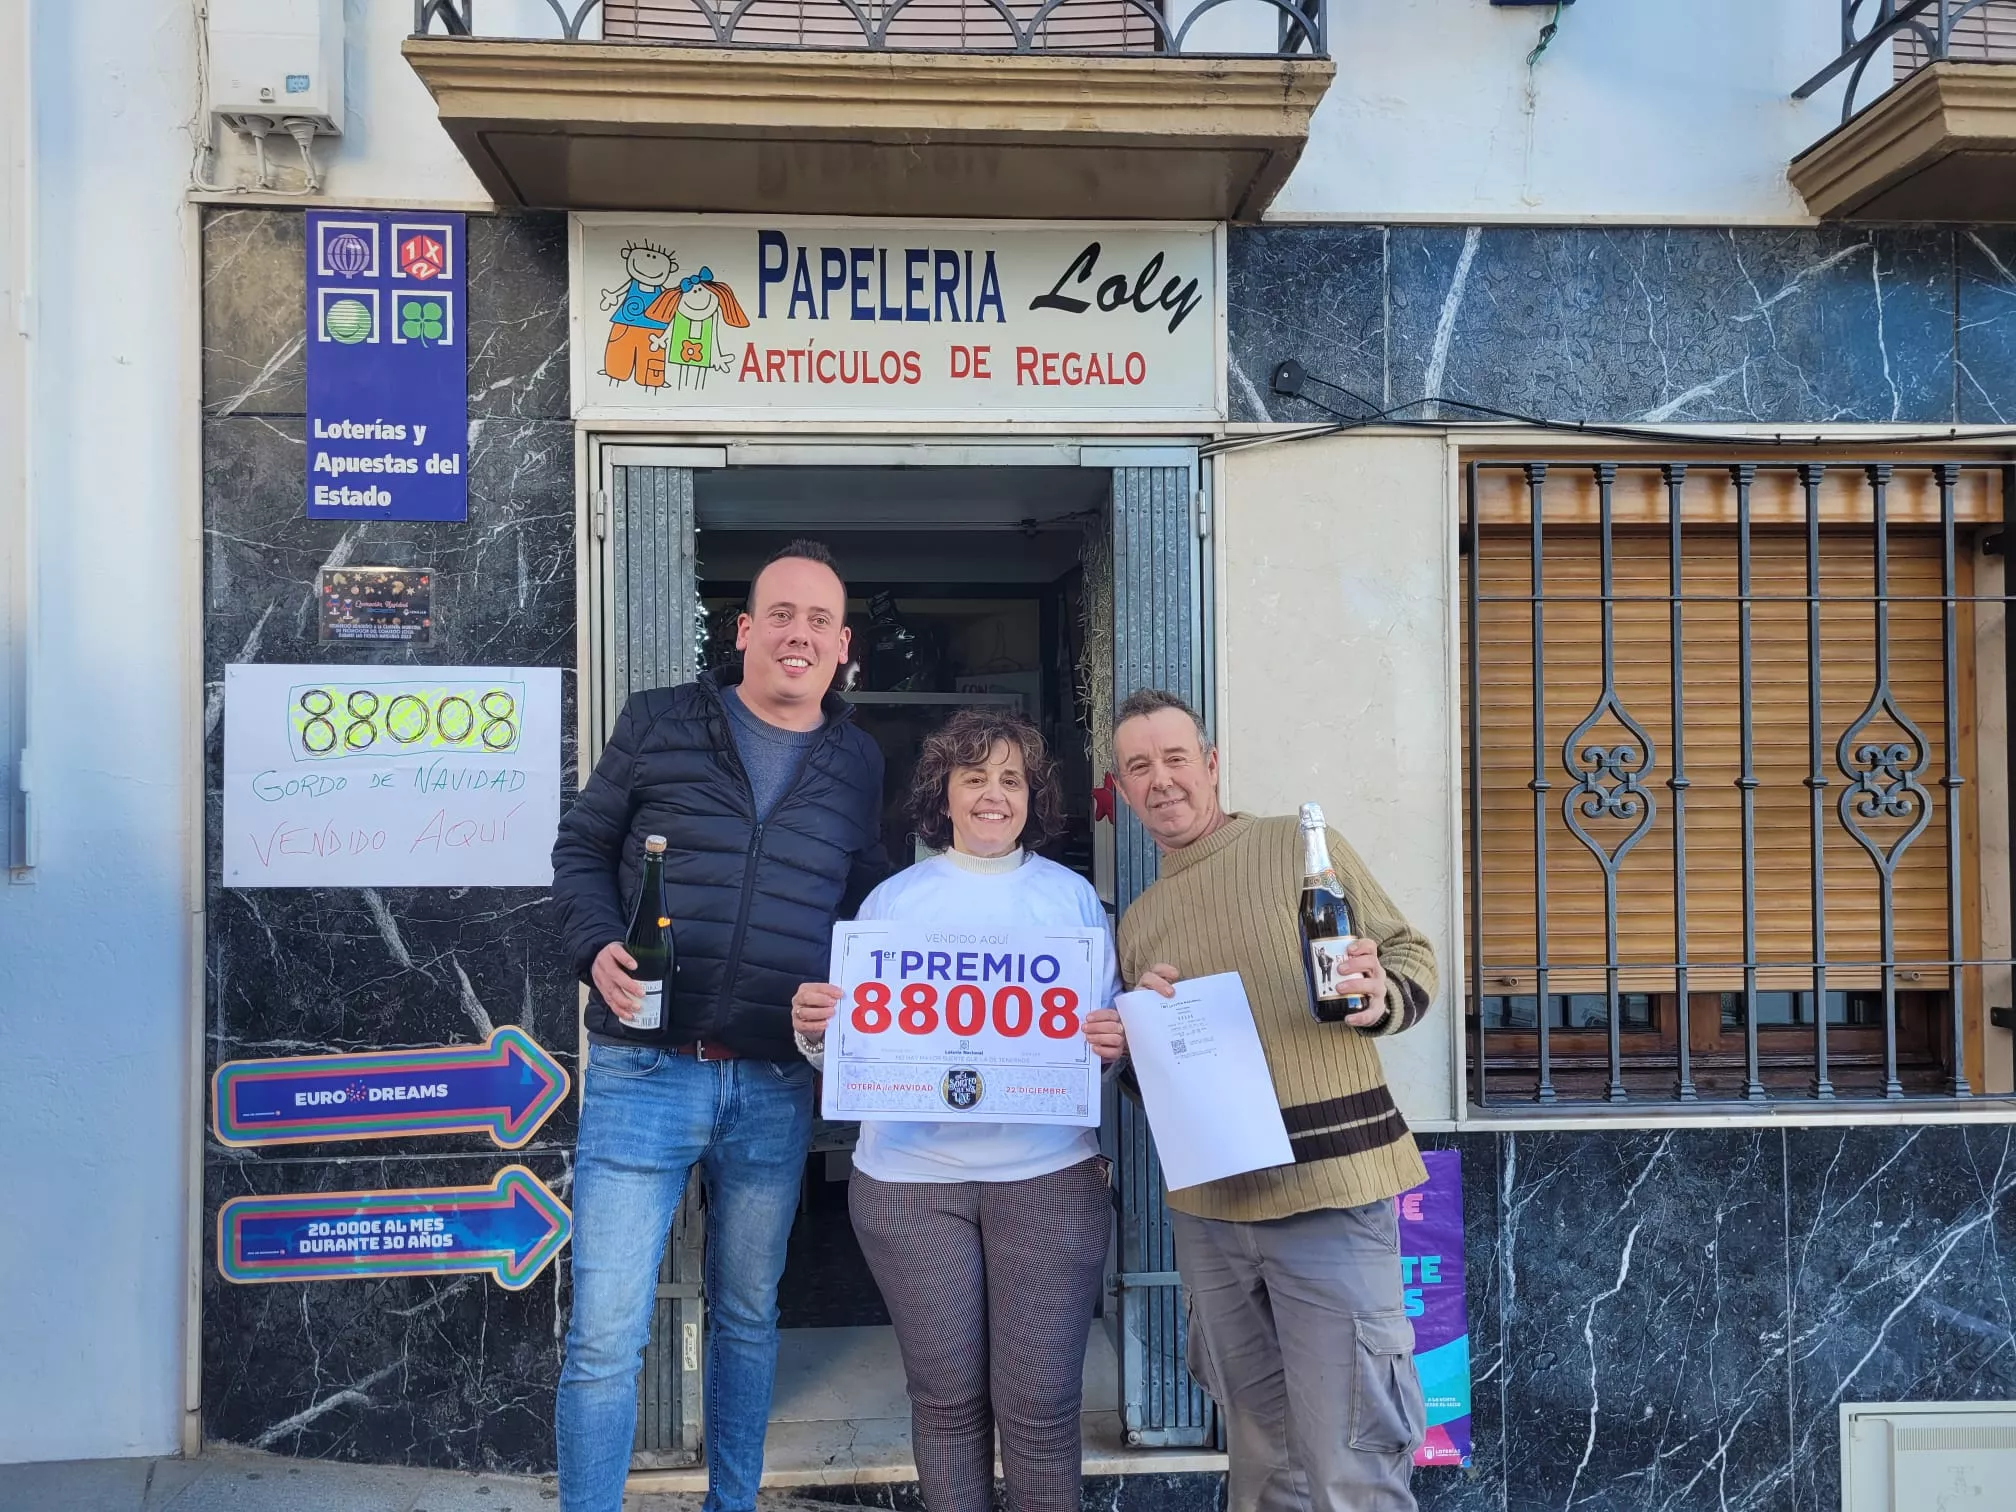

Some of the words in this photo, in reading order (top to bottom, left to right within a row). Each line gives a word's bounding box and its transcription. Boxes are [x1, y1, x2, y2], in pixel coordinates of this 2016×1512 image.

[757, 229, 1007, 324] PAPELERIA
[1029, 241, 1203, 333] Loly
[738, 338, 922, 386] ARTÍCULOS
[950, 344, 992, 380] DE
[1016, 345, 1147, 387] REGALO
[314, 418, 407, 441] Loterías
[413, 425, 427, 446] y
[313, 452, 419, 478] Apuestas
[425, 453, 460, 475] del
[314, 485, 392, 507] Estado
[300, 689, 517, 756] 88008
[252, 770, 348, 802] GORDO
[368, 773, 395, 788] DE
[414, 757, 526, 794] NAVIDAD
[249, 818, 386, 868] VENDIDO
[409, 800, 526, 854] AQUÍ
[925, 933, 977, 944] VENDIDO
[979, 933, 1009, 945] AQUÍ
[870, 950, 897, 979] 1er
[900, 950, 1061, 984] PREMIO
[850, 981, 1080, 1040] 88008
[295, 1090, 347, 1106] EURO
[368, 1083, 449, 1102] DREAMS
[1006, 1086, 1016, 1094] 22
[1019, 1087, 1067, 1095] DICIEMBRE
[384, 1219, 407, 1233] AL
[410, 1217, 444, 1233] MES
[299, 1236, 380, 1254] DURANTE
[383, 1235, 405, 1250] 30
[407, 1232, 453, 1249] AÑOS
